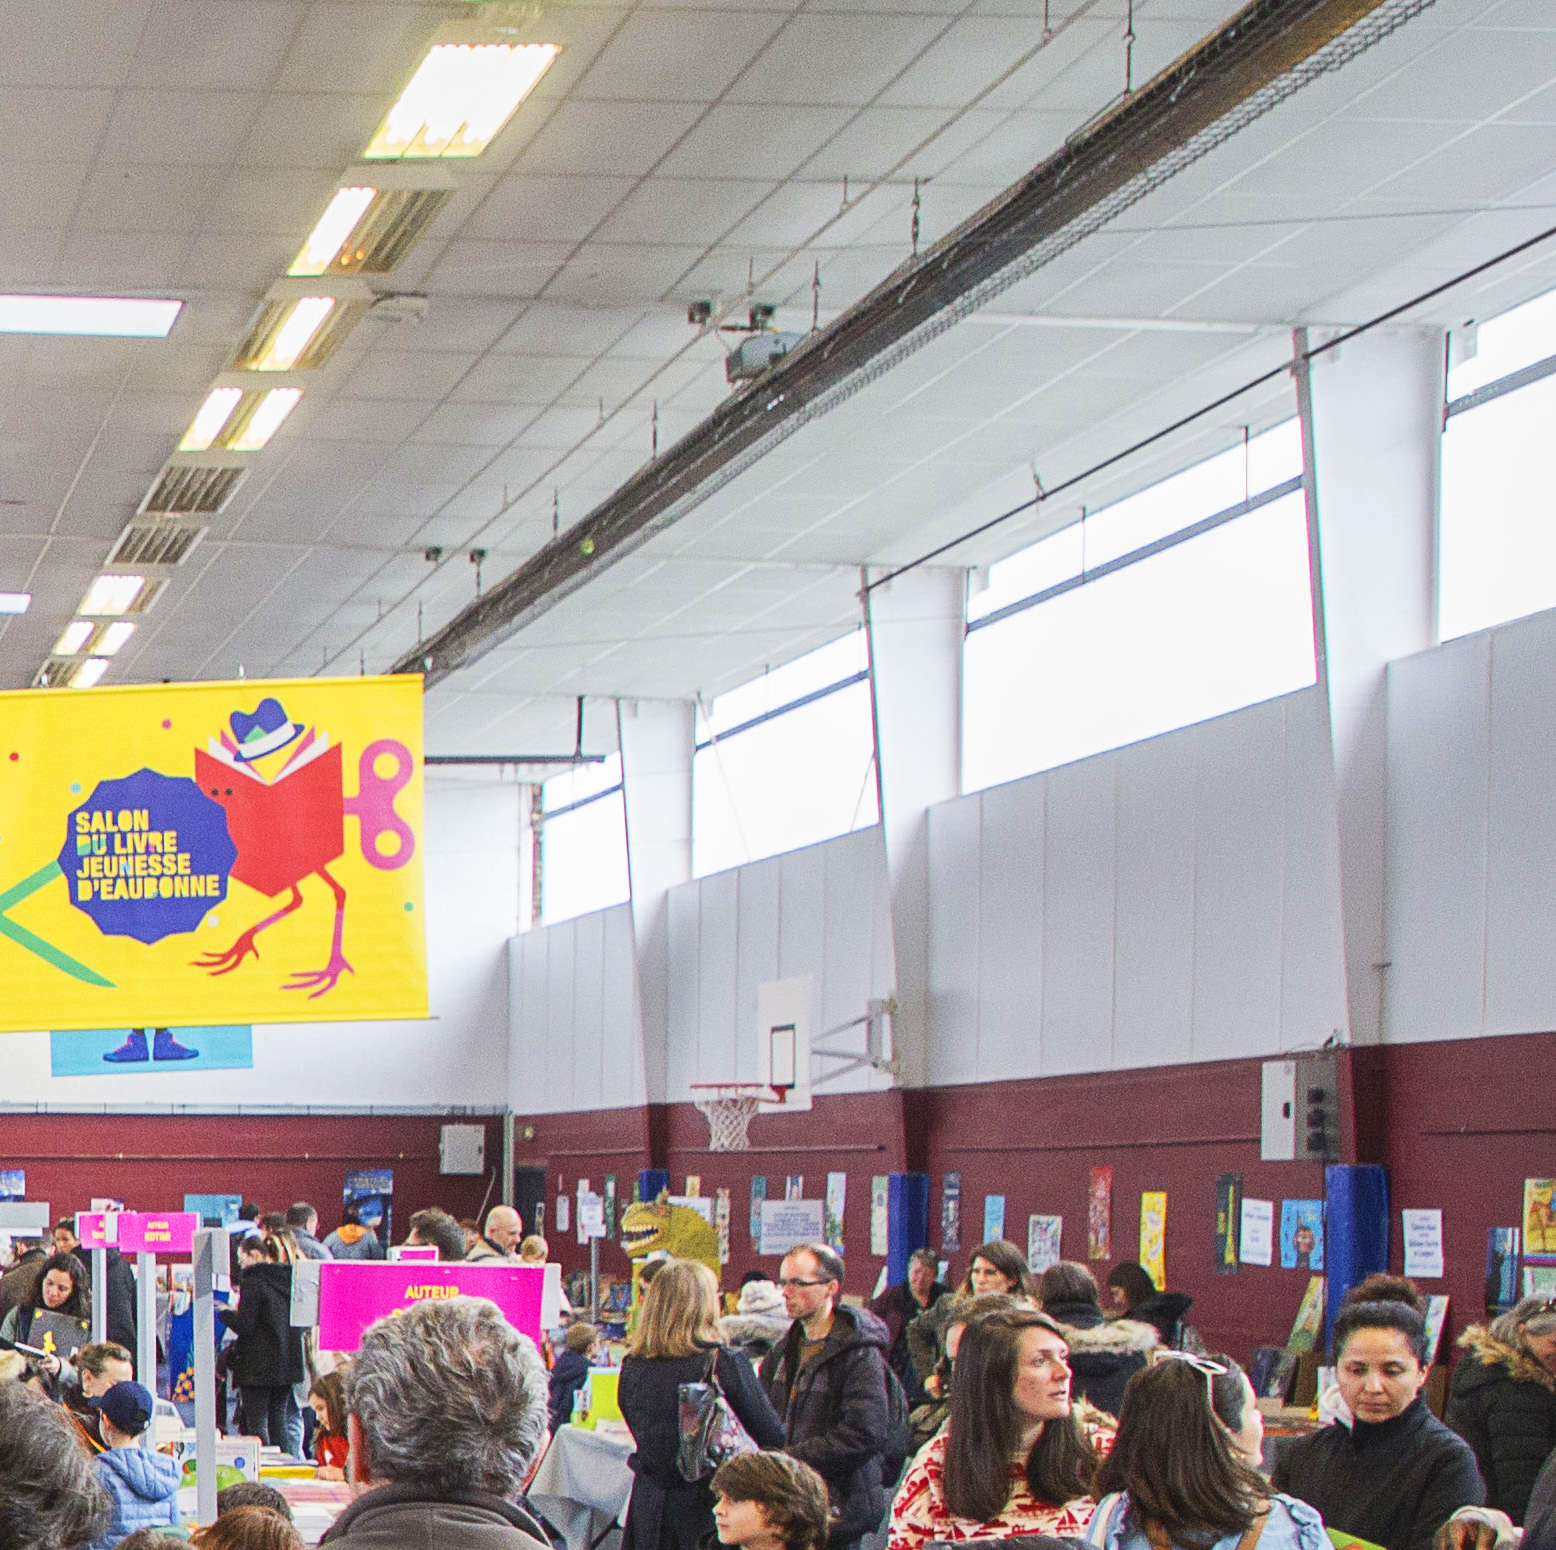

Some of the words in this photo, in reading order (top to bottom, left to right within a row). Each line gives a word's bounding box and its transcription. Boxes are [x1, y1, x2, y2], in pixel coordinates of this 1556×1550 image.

[75, 809, 150, 833] SALON
[76, 833, 108, 856] DU
[114, 830, 178, 854] LIVRE
[76, 852, 191, 878] JEUNESSE
[77, 874, 221, 901] D'EAUBONNE
[405, 1285, 460, 1299] AUTEUR
